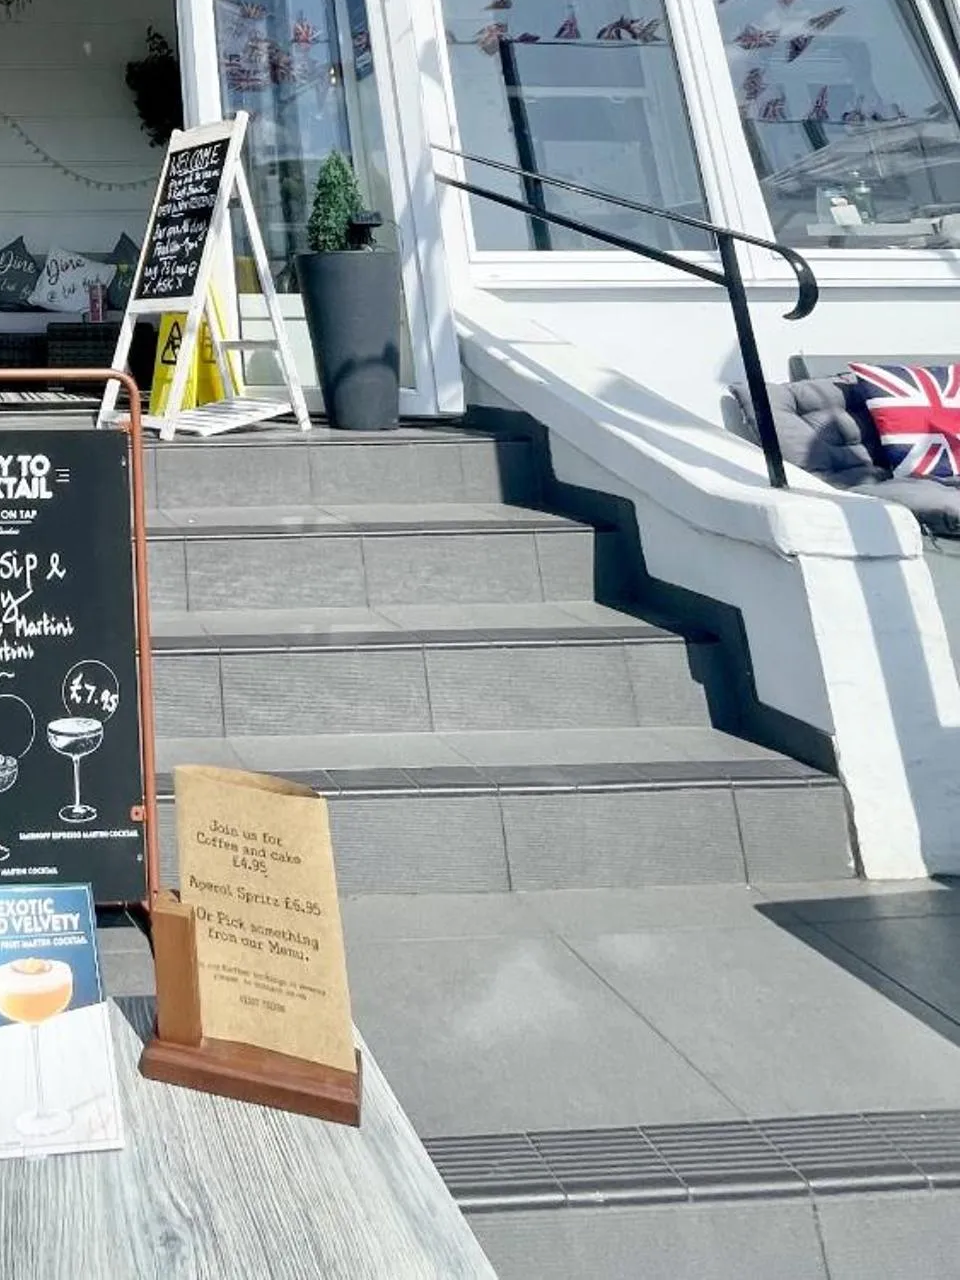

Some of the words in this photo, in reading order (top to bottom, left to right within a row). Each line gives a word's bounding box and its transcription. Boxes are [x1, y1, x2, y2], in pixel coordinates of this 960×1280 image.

[18, 454, 51, 477] TO
[0, 509, 17, 520] ON
[19, 509, 37, 519] TAP
[14, 614, 75, 638] Martini
[209, 819, 239, 838] Join
[242, 830, 258, 841] us
[196, 830, 239, 853] Coffee
[242, 845, 267, 859] and
[270, 851, 302, 865] cake
[237, 886, 281, 907] Spritz
[11, 912, 81, 934] VELVETY
[196, 906, 214, 922] Or
[250, 923, 320, 951] something
[241, 937, 263, 950] our
